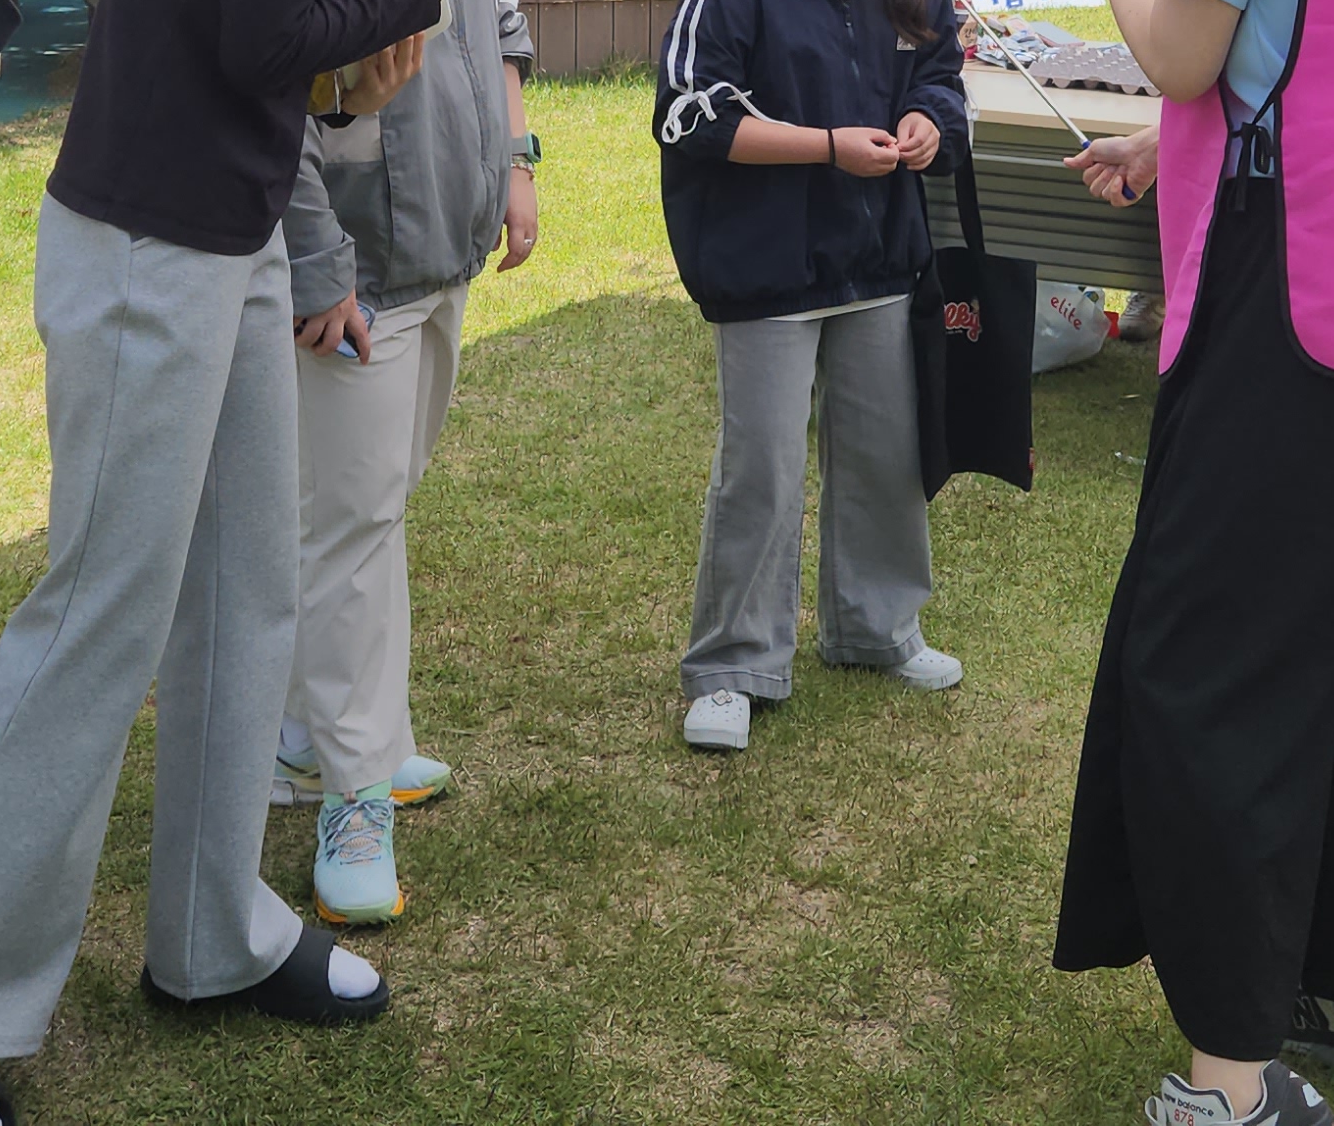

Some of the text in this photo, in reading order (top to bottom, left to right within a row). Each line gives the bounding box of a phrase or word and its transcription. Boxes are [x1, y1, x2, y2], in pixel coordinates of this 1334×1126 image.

[1050, 295, 1083, 331] elite
[1173, 1108, 1195, 1126] 878
[1177, 1097, 1215, 1118] balance
